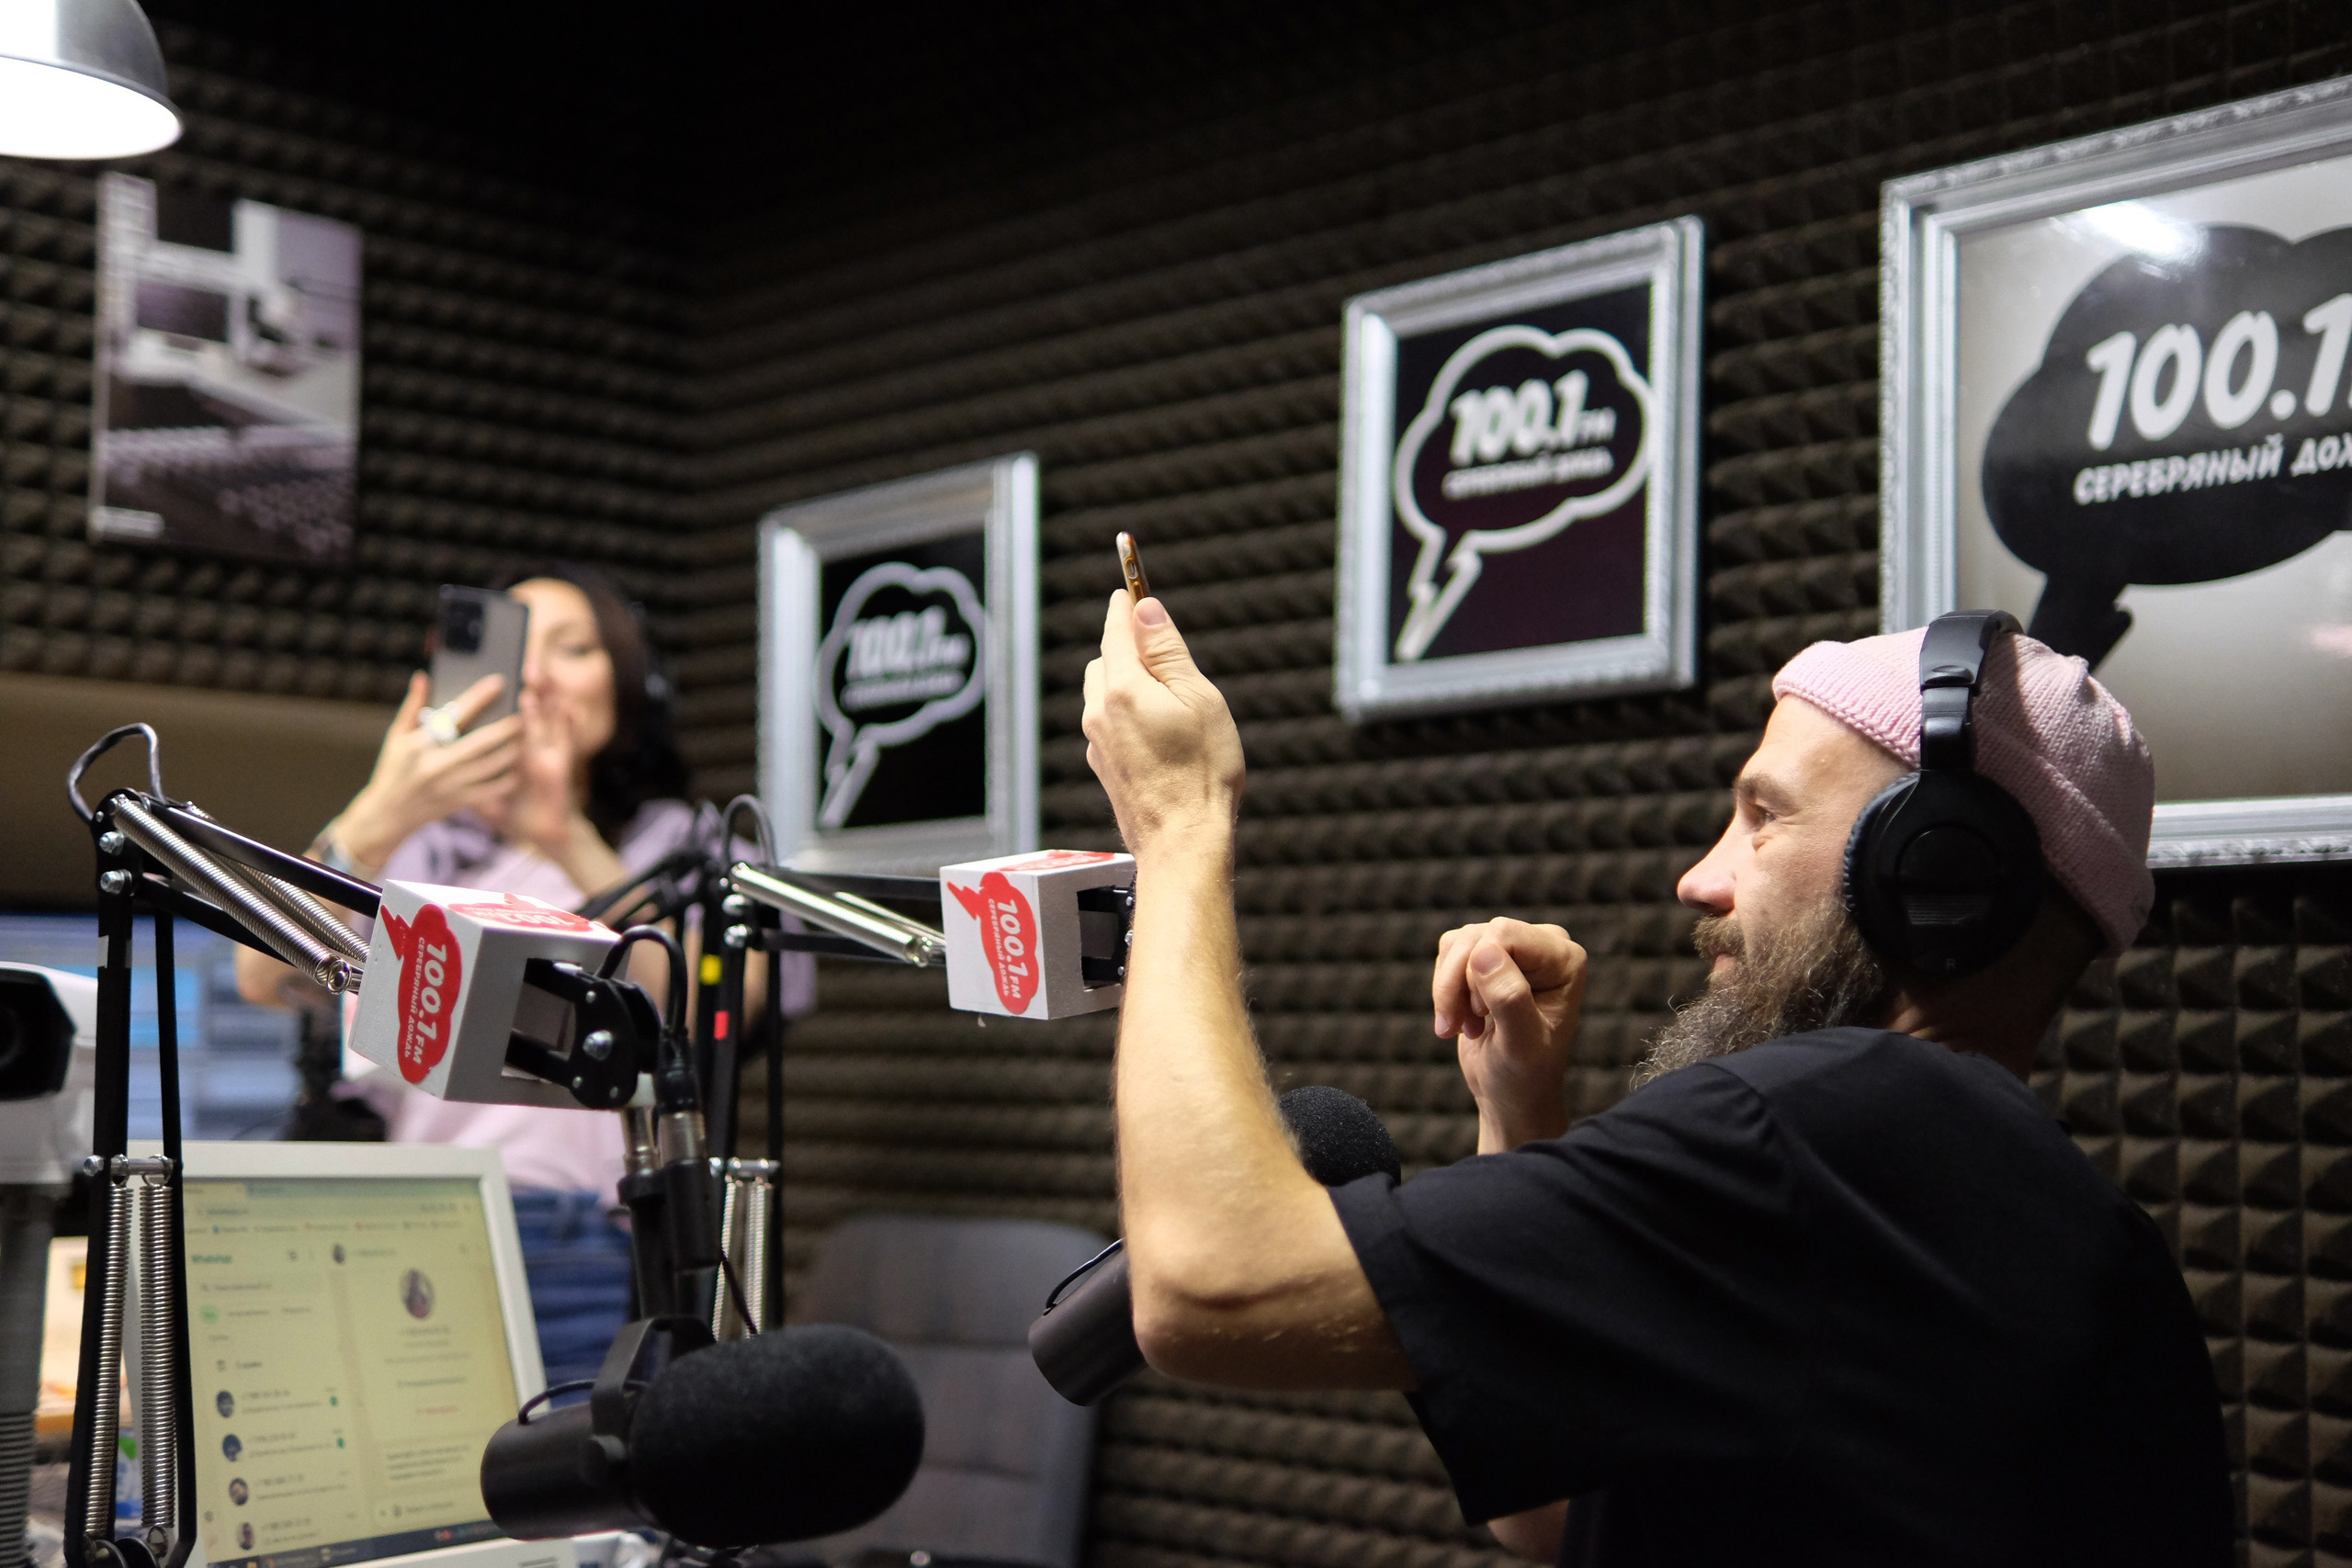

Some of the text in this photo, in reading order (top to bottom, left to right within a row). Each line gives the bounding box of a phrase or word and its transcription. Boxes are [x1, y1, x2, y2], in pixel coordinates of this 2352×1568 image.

[2074, 433, 2284, 505] СЕРЕБРЯНЫЙ
[988, 898, 1010, 997] СЕРЕБРЯНЫЙ ДОЖДЬ
[1945, 958, 1956, 970] R
[404, 937, 425, 1058] СЕРЕБРЯНЫЙ ДОЖДЬ
